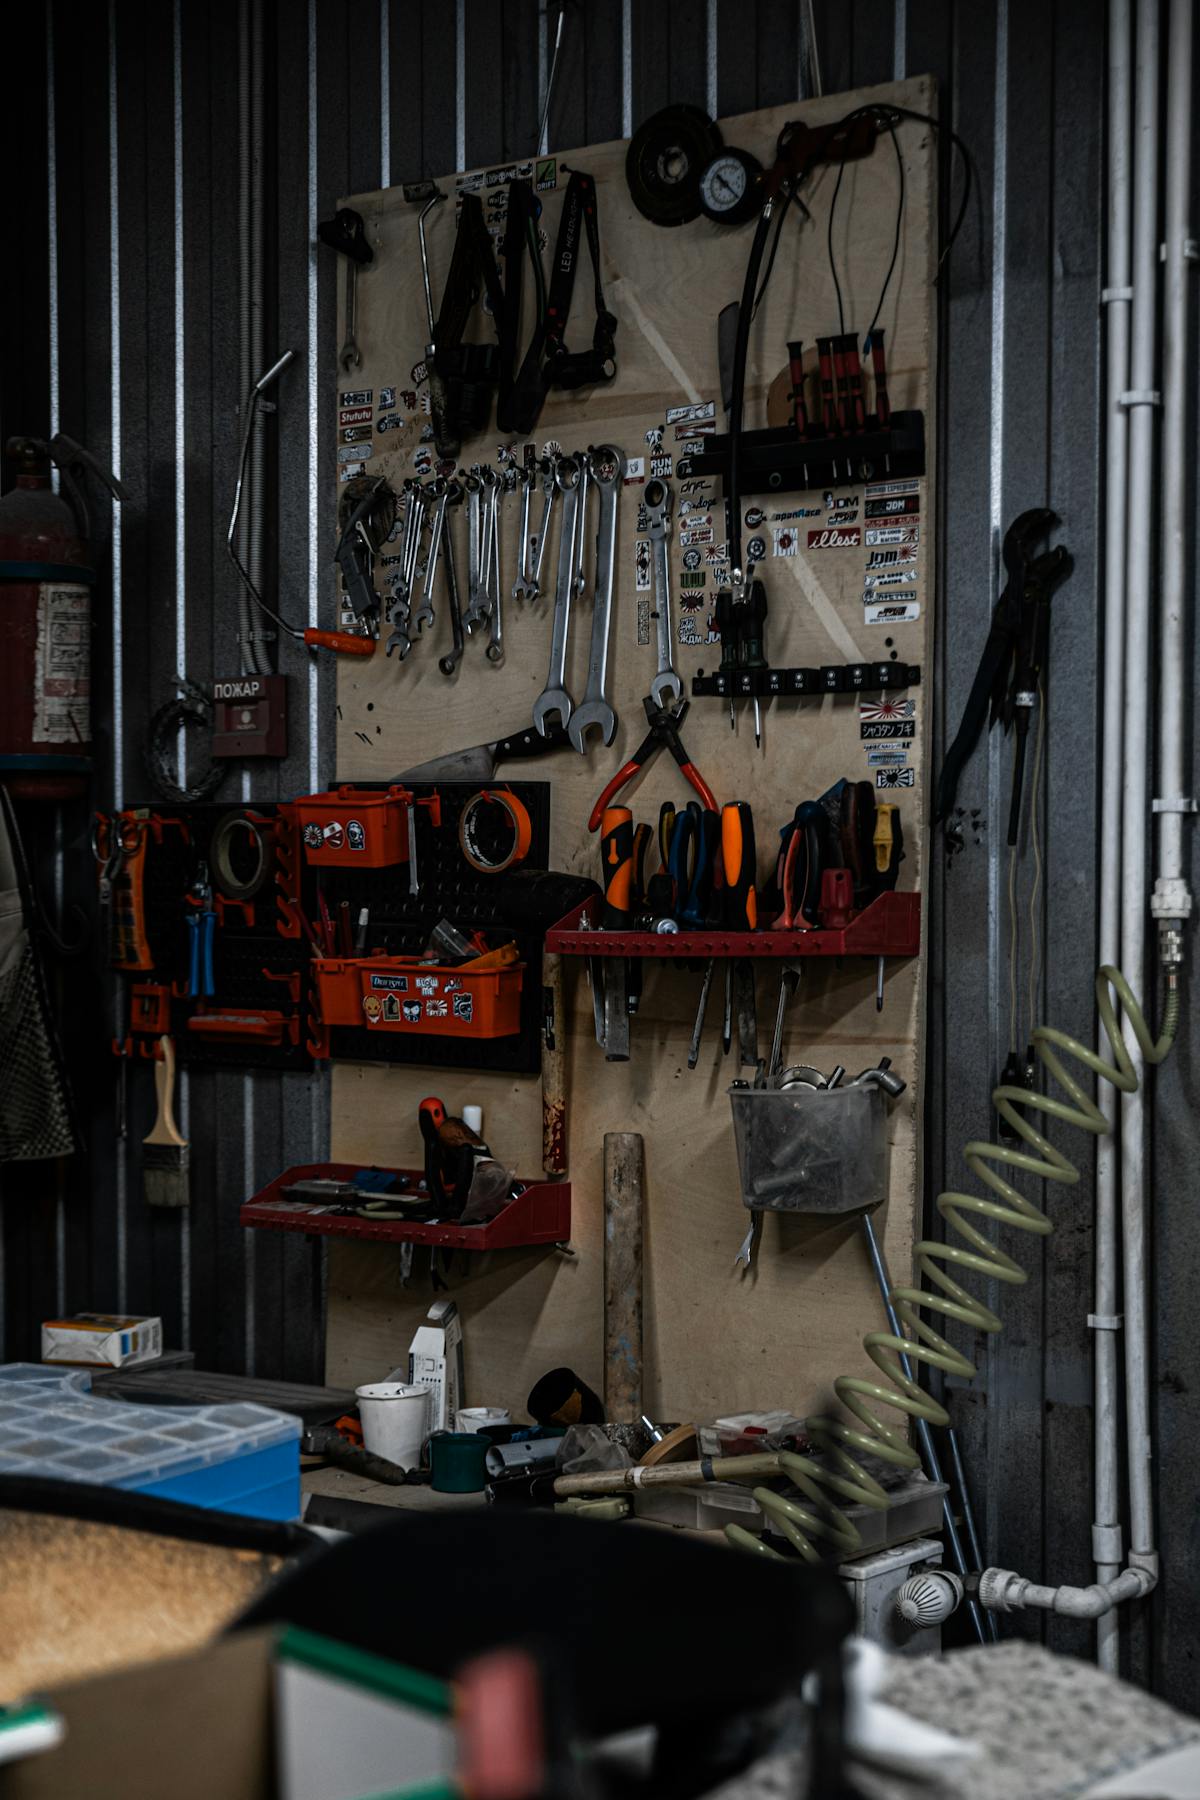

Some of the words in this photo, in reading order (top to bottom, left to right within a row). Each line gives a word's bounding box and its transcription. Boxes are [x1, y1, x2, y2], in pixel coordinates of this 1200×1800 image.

[536, 180, 556, 192] DRIFT
[560, 251, 573, 273] LED
[341, 411, 372, 423] Stututu
[650, 457, 673, 469] RUN
[650, 466, 673, 479] JDM
[885, 500, 906, 511] JDM
[807, 530, 860, 549] illest
[680, 633, 702, 646] ЖДМ
[214, 681, 260, 698] ПОЖАР
